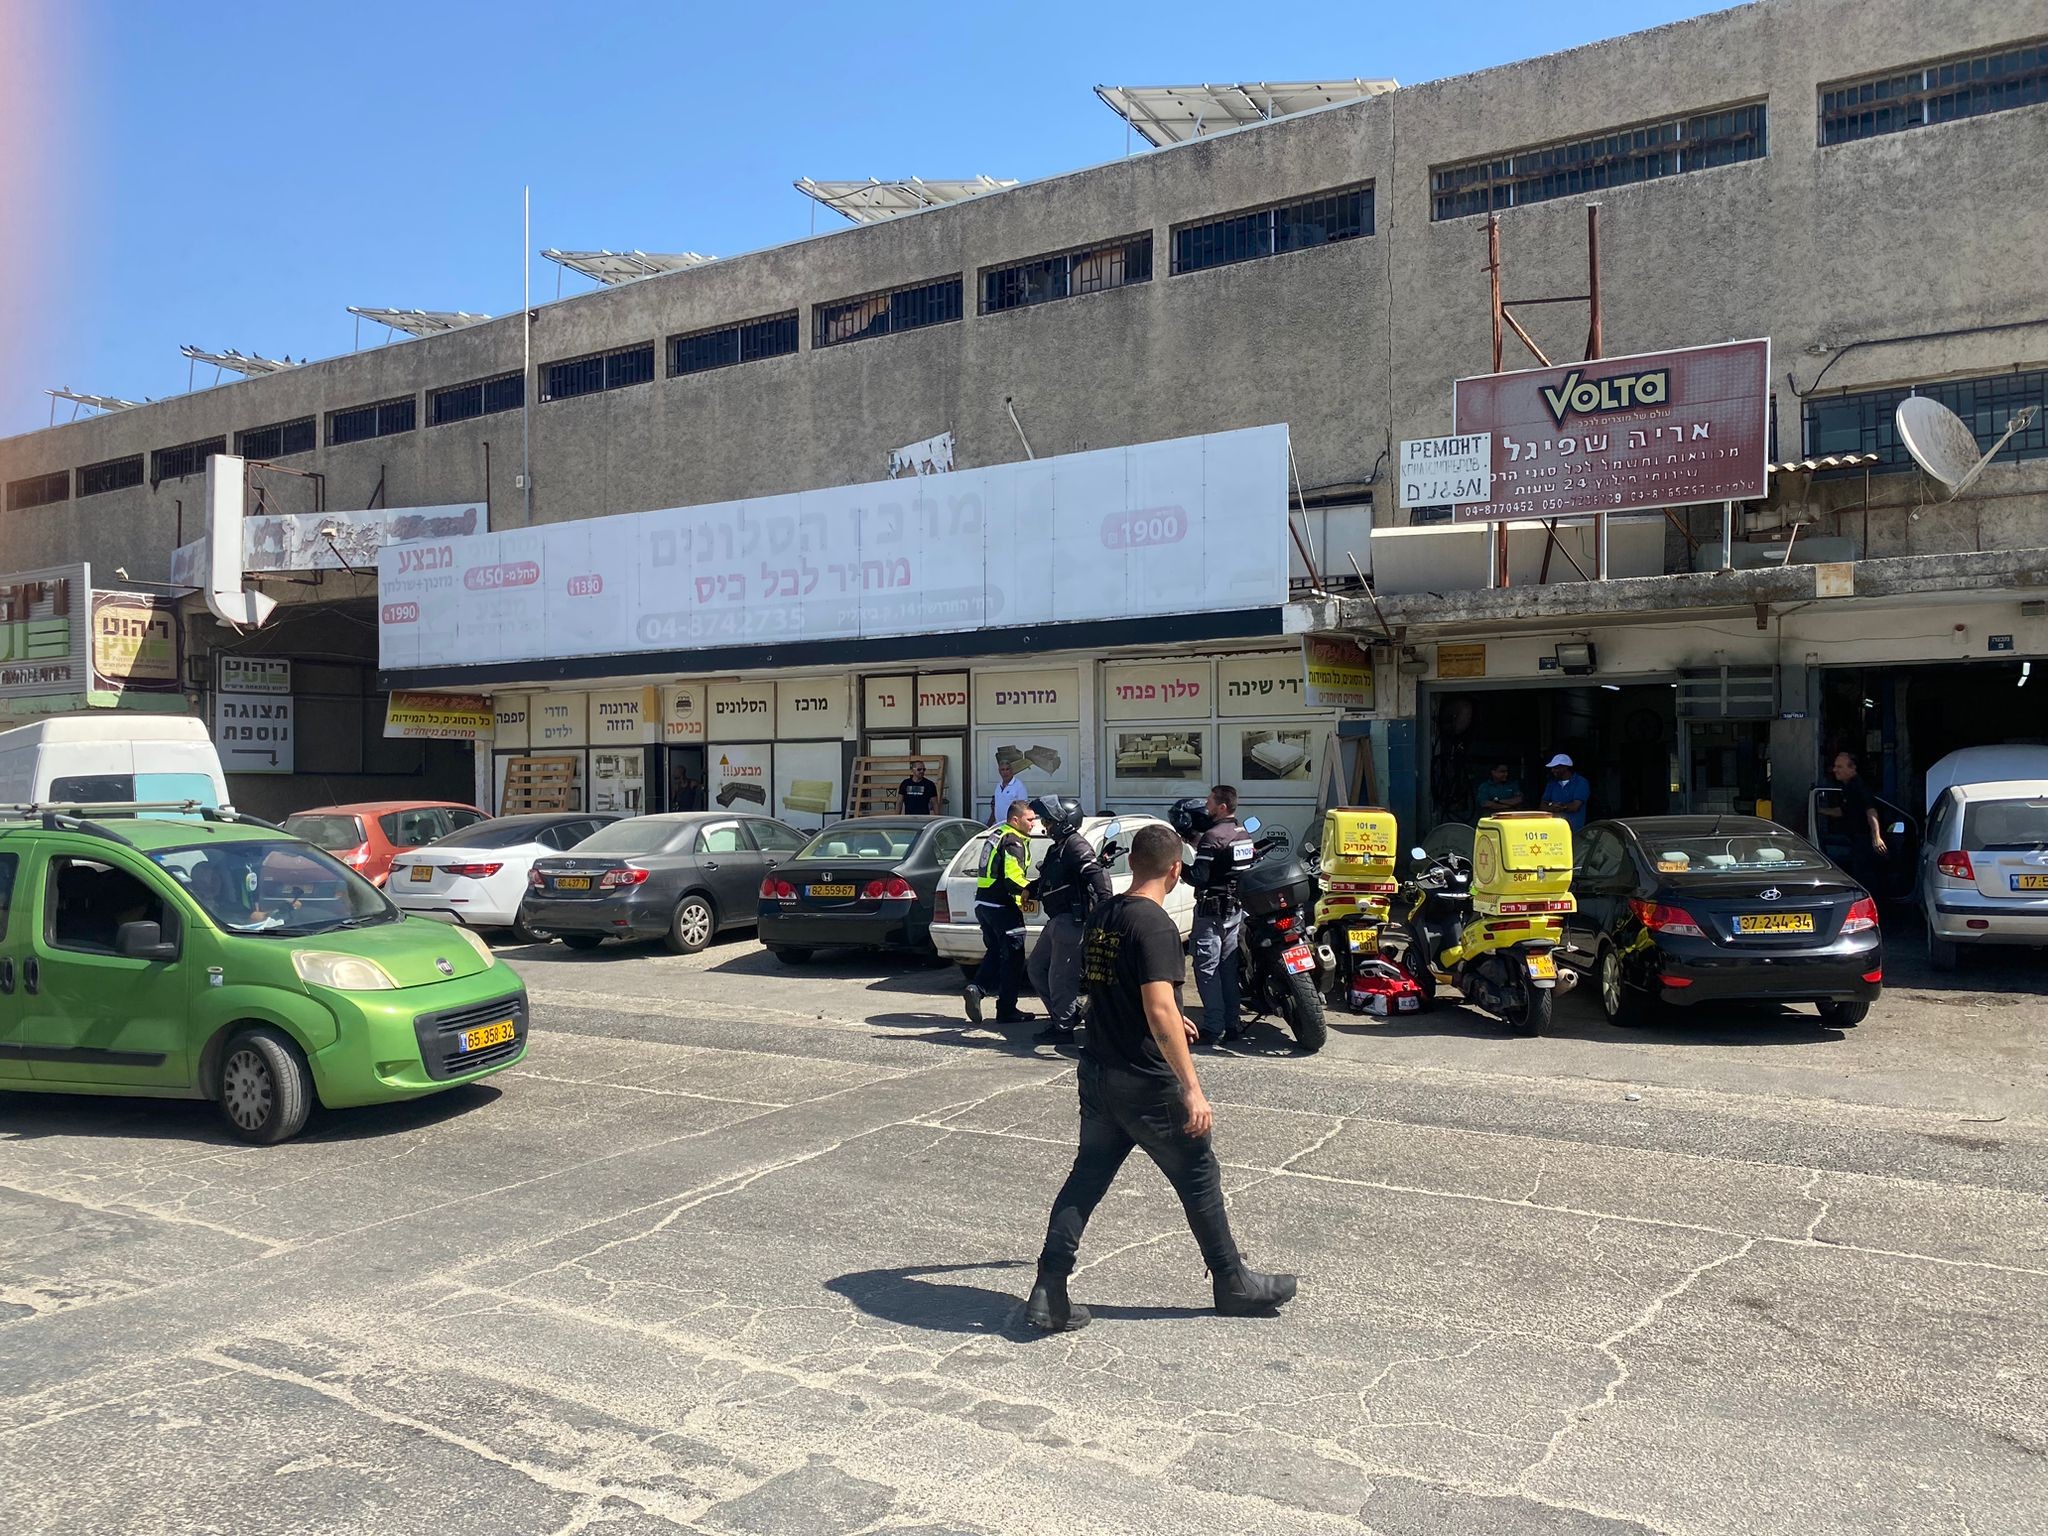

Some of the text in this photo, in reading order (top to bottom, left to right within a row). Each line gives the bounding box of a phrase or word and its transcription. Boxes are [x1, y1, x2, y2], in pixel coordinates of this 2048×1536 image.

[1601, 415, 1632, 425] מוצרים
[1633, 412, 1647, 420] של
[1650, 410, 1671, 419] עולם
[1503, 422, 1710, 462] אריה שפיגל
[1667, 447, 1739, 465] מכונאות
[1525, 467, 1558, 479] סוגי
[1564, 460, 1593, 475] לכל
[1490, 471, 1518, 483] הרכ
[1645, 469, 1698, 481] שירותי
[1514, 483, 1556, 496] שעות
[1564, 478, 1587, 491] 24
[1465, 500, 1534, 517] 04-8770452
[398, 545, 453, 575] מבצע
[694, 556, 912, 604] מחיר לכל כיס
[103, 617, 169, 639] ריהוט
[224, 660, 289, 673] ריהוט
[1116, 679, 1200, 703] סלון פנתי
[1228, 678, 1274, 697] שינה
[878, 694, 896, 708] בר
[919, 691, 966, 706] כסאות
[995, 689, 1057, 705] מזרונים
[599, 702, 639, 715] ארונות
[716, 697, 767, 714] הסלונים
[795, 697, 828, 711] מרכז
[223, 703, 288, 719] תצוגה
[496, 711, 525, 724] ספפה
[544, 705, 568, 718] חדרי
[390, 713, 426, 723] המידות
[428, 713, 439, 725] כל
[479, 715, 490, 726] כל
[606, 719, 634, 731] הזזה
[667, 721, 702, 734] כניסה
[223, 725, 288, 741] נוספת
[544, 725, 572, 739] ילדים
[1356, 822, 1368, 830] 101
[1525, 832, 1538, 840] 101
[1343, 843, 1387, 852] פראמדיק
[1513, 873, 1532, 881] 5647
